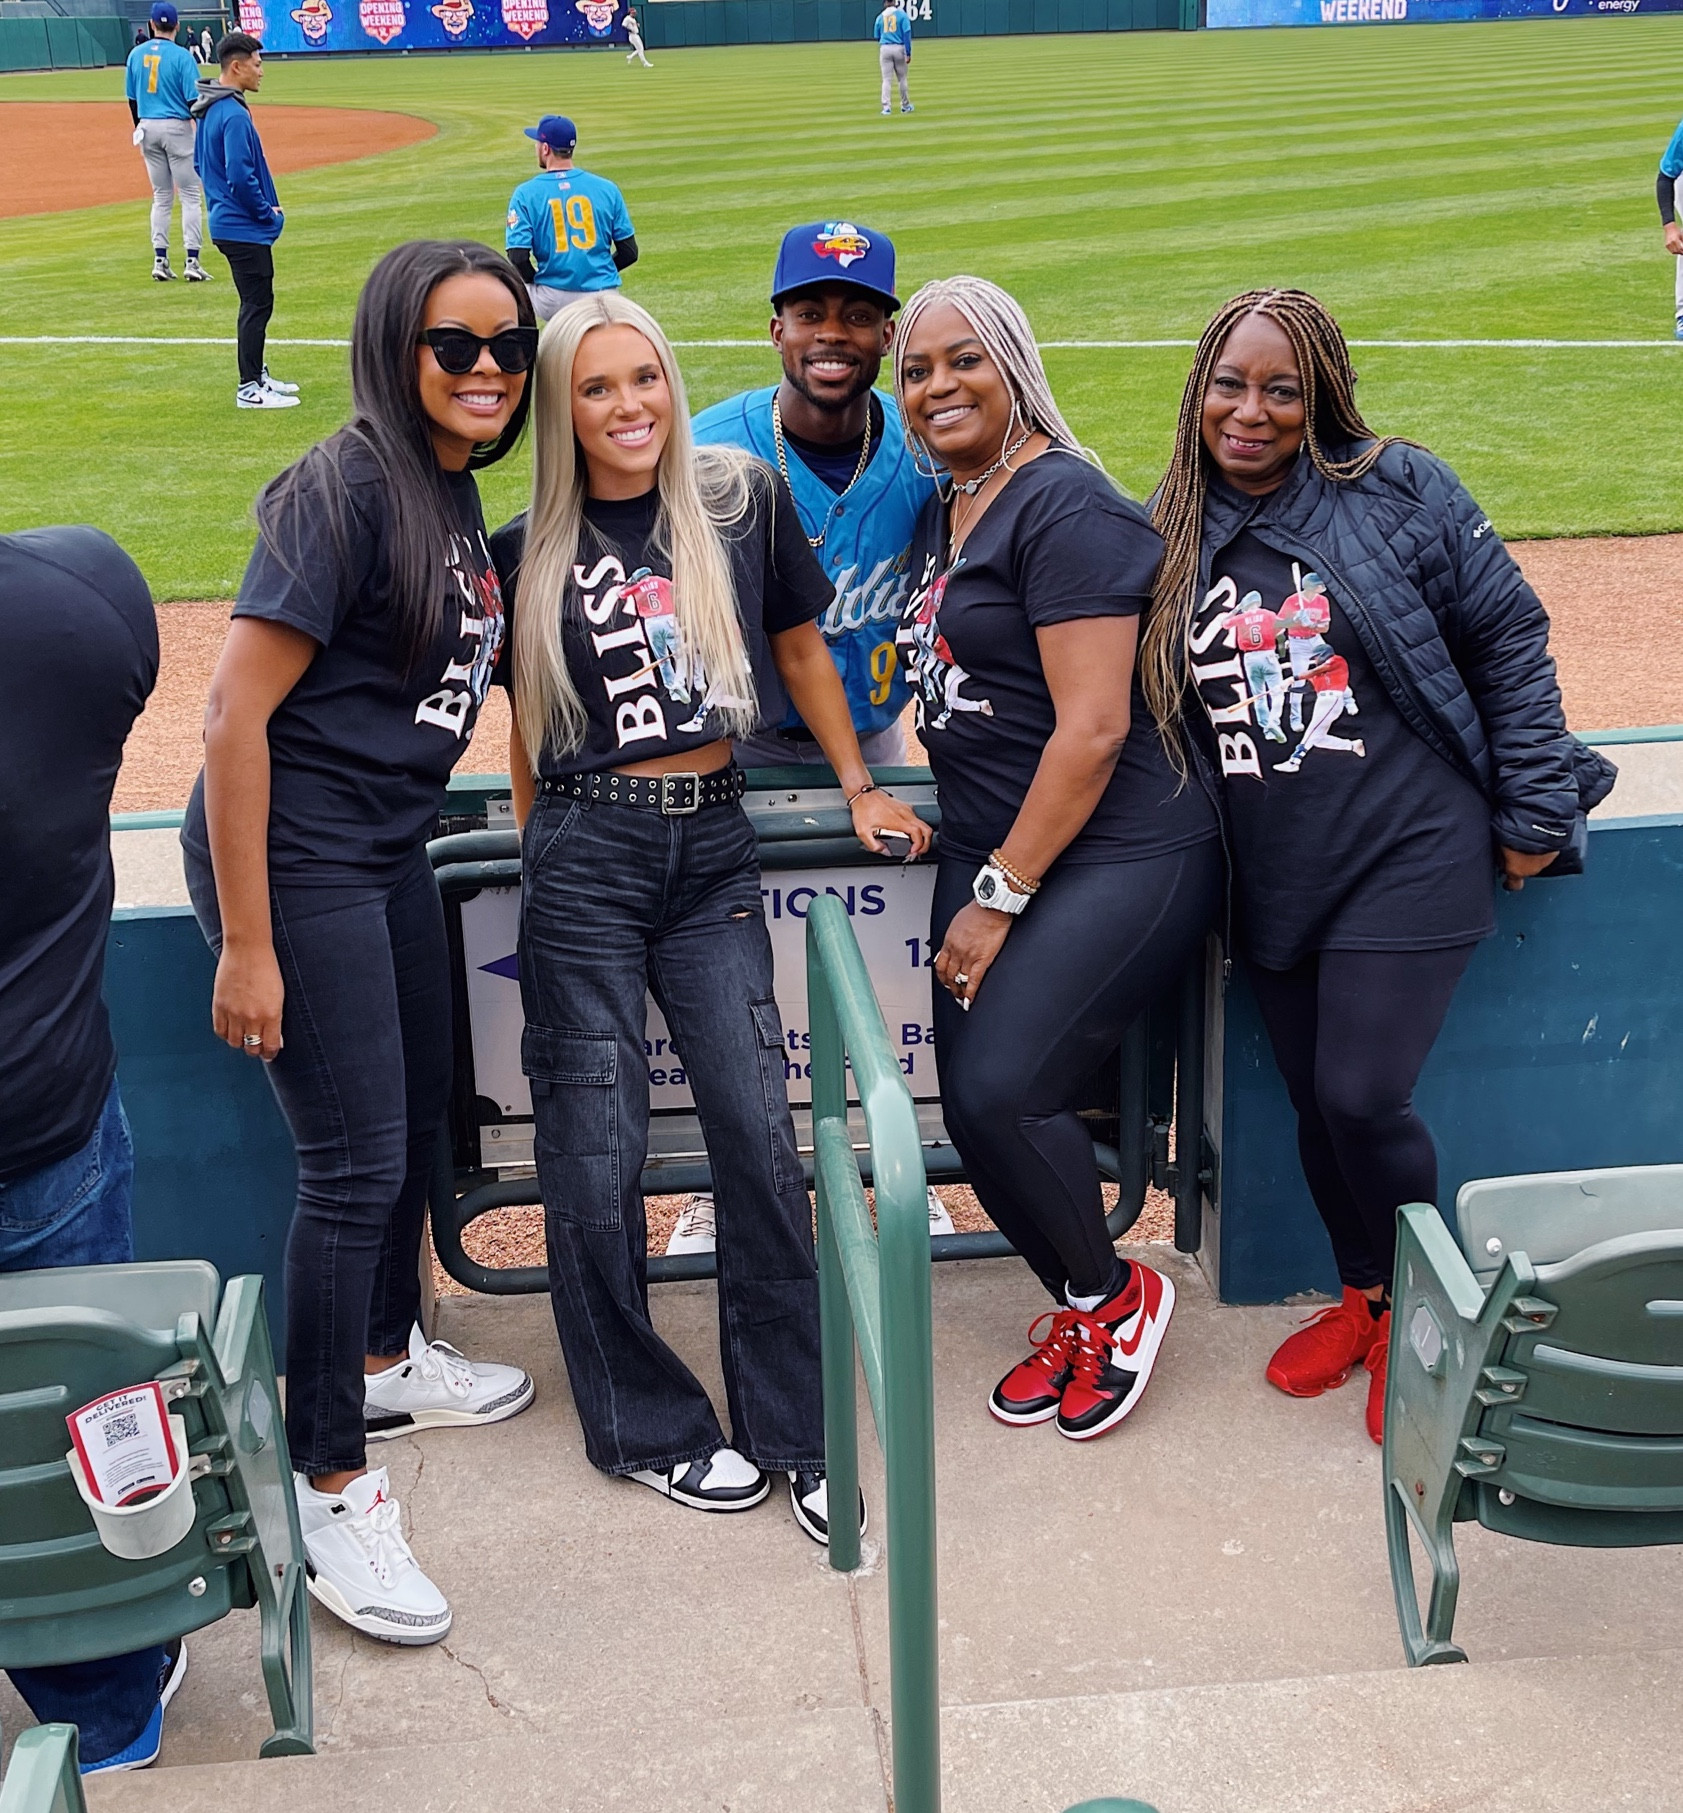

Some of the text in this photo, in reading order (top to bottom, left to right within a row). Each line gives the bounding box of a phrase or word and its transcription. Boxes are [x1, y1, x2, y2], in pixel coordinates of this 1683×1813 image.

[360, 2, 402, 13] OPENING
[503, 10, 548, 22] WEEKEND
[1321, 1, 1407, 21] WEEKEND
[1598, 0, 1640, 12] energy
[361, 14, 404, 26] WEEKEND
[143, 54, 162, 93] 7
[548, 195, 597, 253] 19
[647, 591, 661, 611] 6
[1250, 625, 1263, 645] 6
[573, 555, 667, 749] BLISS
[870, 641, 897, 706] 9
[1188, 575, 1263, 779] BLISS
[85, 1395, 147, 1424] DELIVERED!
[96, 1399, 115, 1411] GET
